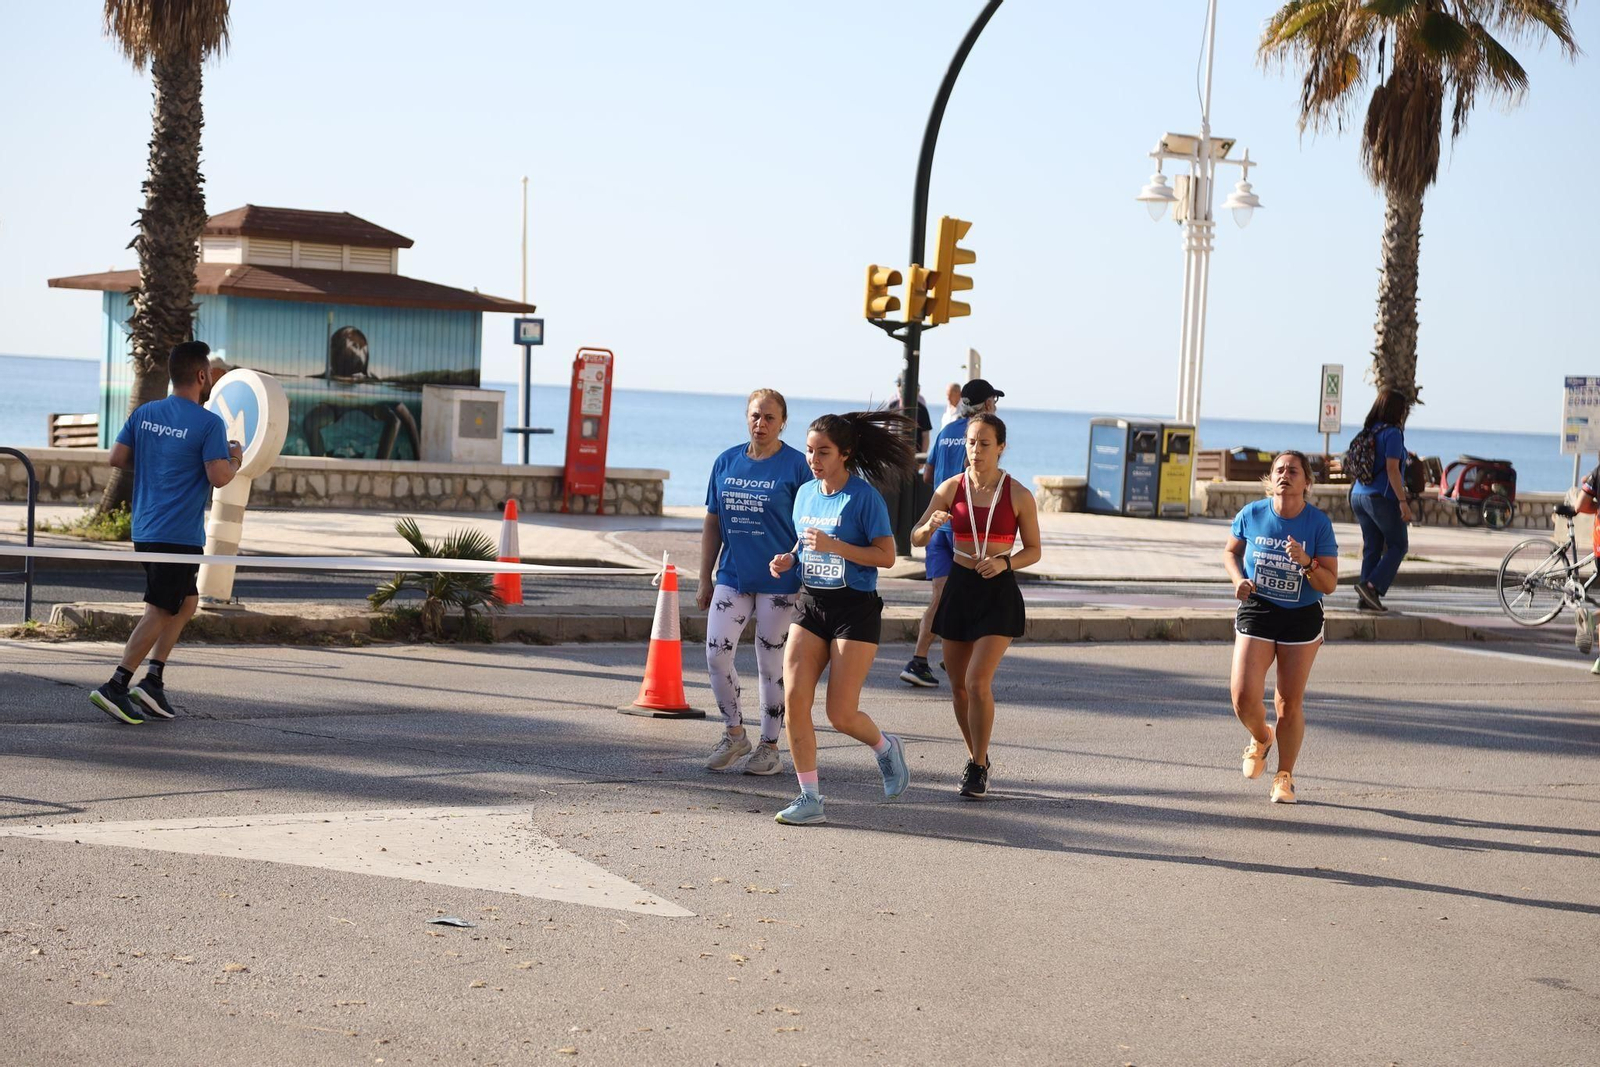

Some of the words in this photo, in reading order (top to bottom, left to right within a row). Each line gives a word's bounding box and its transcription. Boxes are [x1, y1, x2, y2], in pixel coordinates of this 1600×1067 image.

[1325, 404, 1336, 416] 31
[141, 420, 188, 439] mayoral
[724, 477, 775, 490] mayoral
[721, 490, 768, 501] RUNNING
[725, 498, 763, 507] MAKES
[725, 504, 764, 513] FRIENDS
[798, 515, 842, 528] mayoral
[1255, 536, 1306, 552] mayol
[1252, 551, 1298, 565] RUNNIN
[806, 563, 839, 577] 2026
[1260, 576, 1296, 591] 1889
